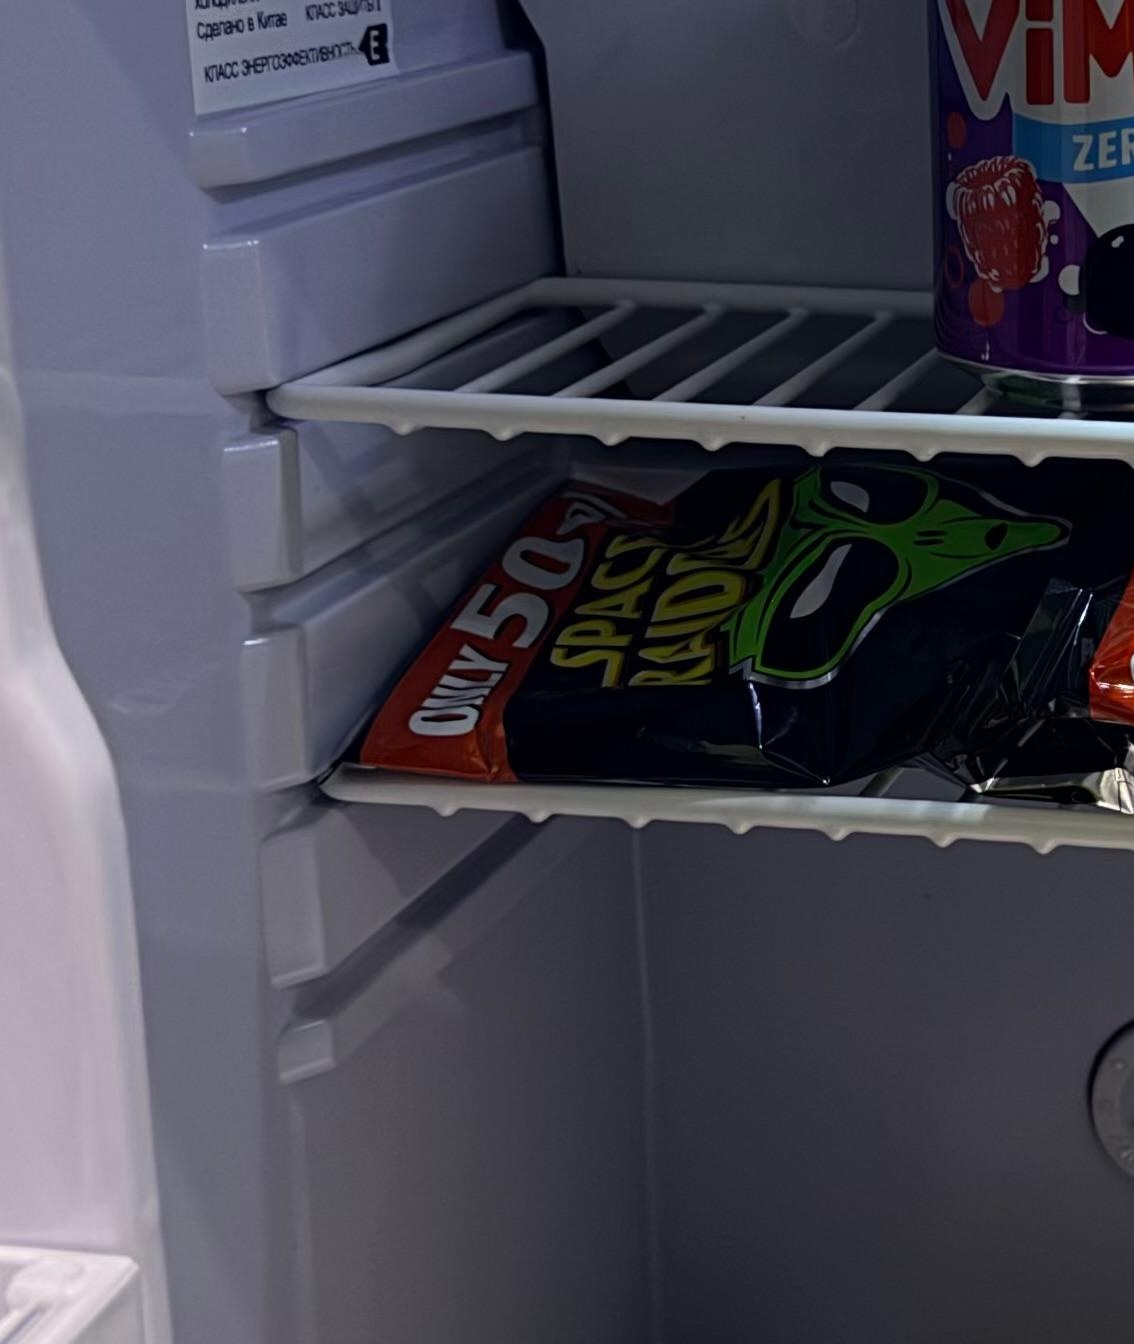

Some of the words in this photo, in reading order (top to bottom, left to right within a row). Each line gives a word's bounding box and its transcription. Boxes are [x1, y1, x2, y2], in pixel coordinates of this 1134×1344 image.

[197, 20, 245, 41] Сделано
[247, 18, 254, 31] в
[257, 10, 288, 30] Китае
[204, 62, 240, 83] КЛАСС
[408, 643, 509, 736] ONLY
